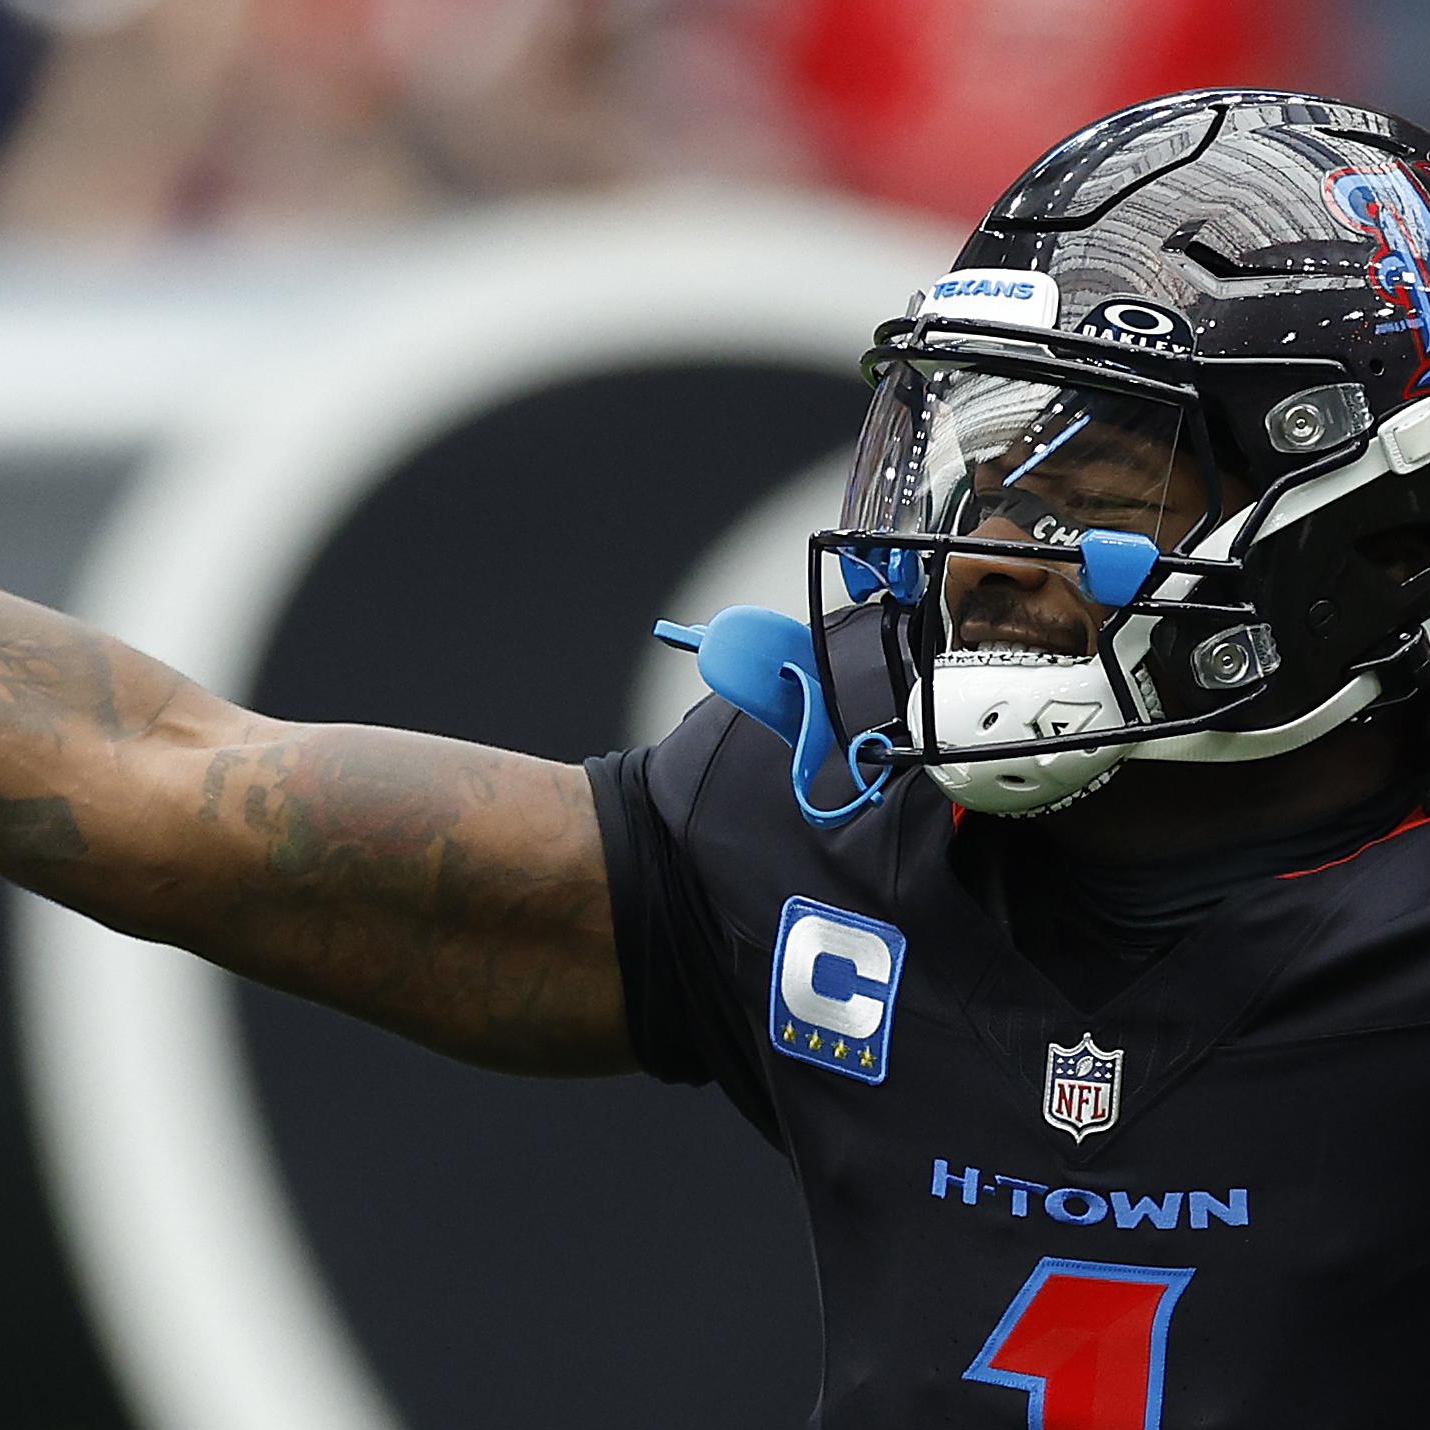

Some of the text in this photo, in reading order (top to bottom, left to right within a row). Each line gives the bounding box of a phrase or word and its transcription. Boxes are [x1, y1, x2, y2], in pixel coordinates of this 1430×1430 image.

[933, 279, 1036, 300] TEXANS
[1081, 324, 1186, 354] OAKLEY
[781, 914, 892, 1039] C
[1055, 1083, 1106, 1123] NFL
[930, 1158, 1250, 1230] H-TOWN
